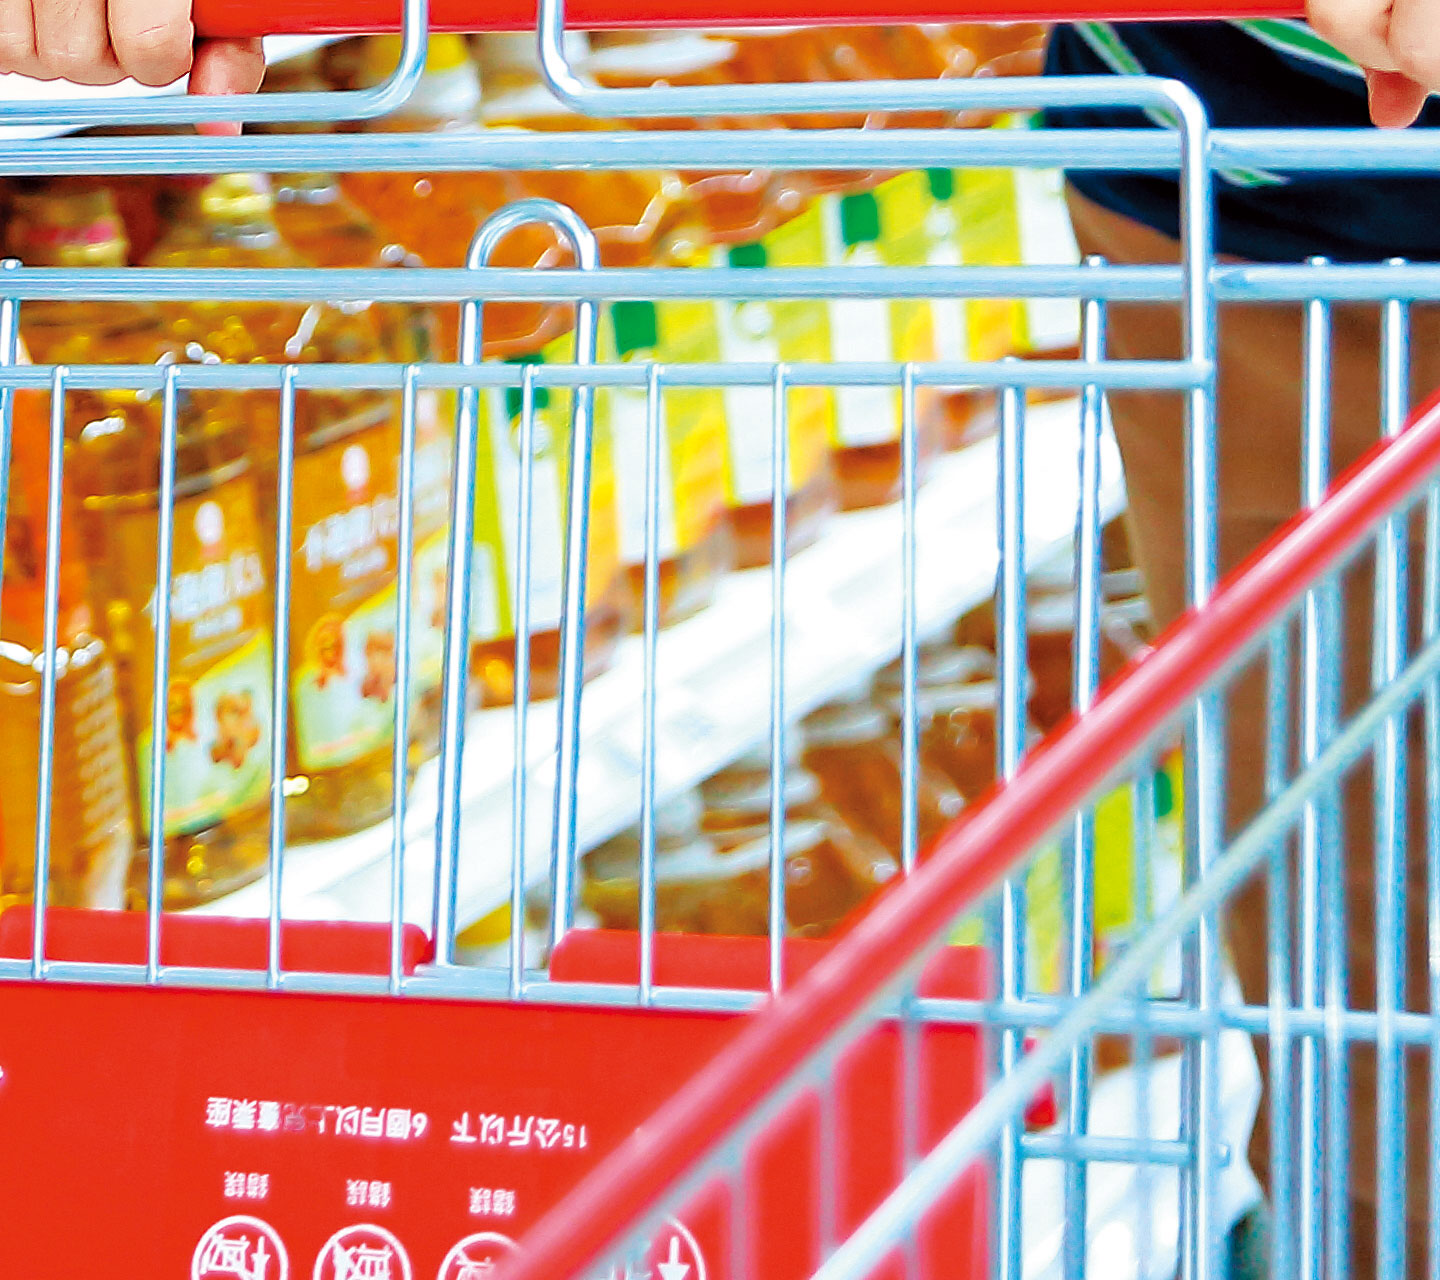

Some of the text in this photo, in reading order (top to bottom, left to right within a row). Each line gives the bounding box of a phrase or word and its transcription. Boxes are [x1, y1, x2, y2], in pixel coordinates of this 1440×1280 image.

[450, 1111, 588, 1150] 15公斤以下
[224, 1170, 270, 1201] 錯誤
[346, 1178, 392, 1209] 錯誤
[468, 1186, 517, 1217] 錯誤
